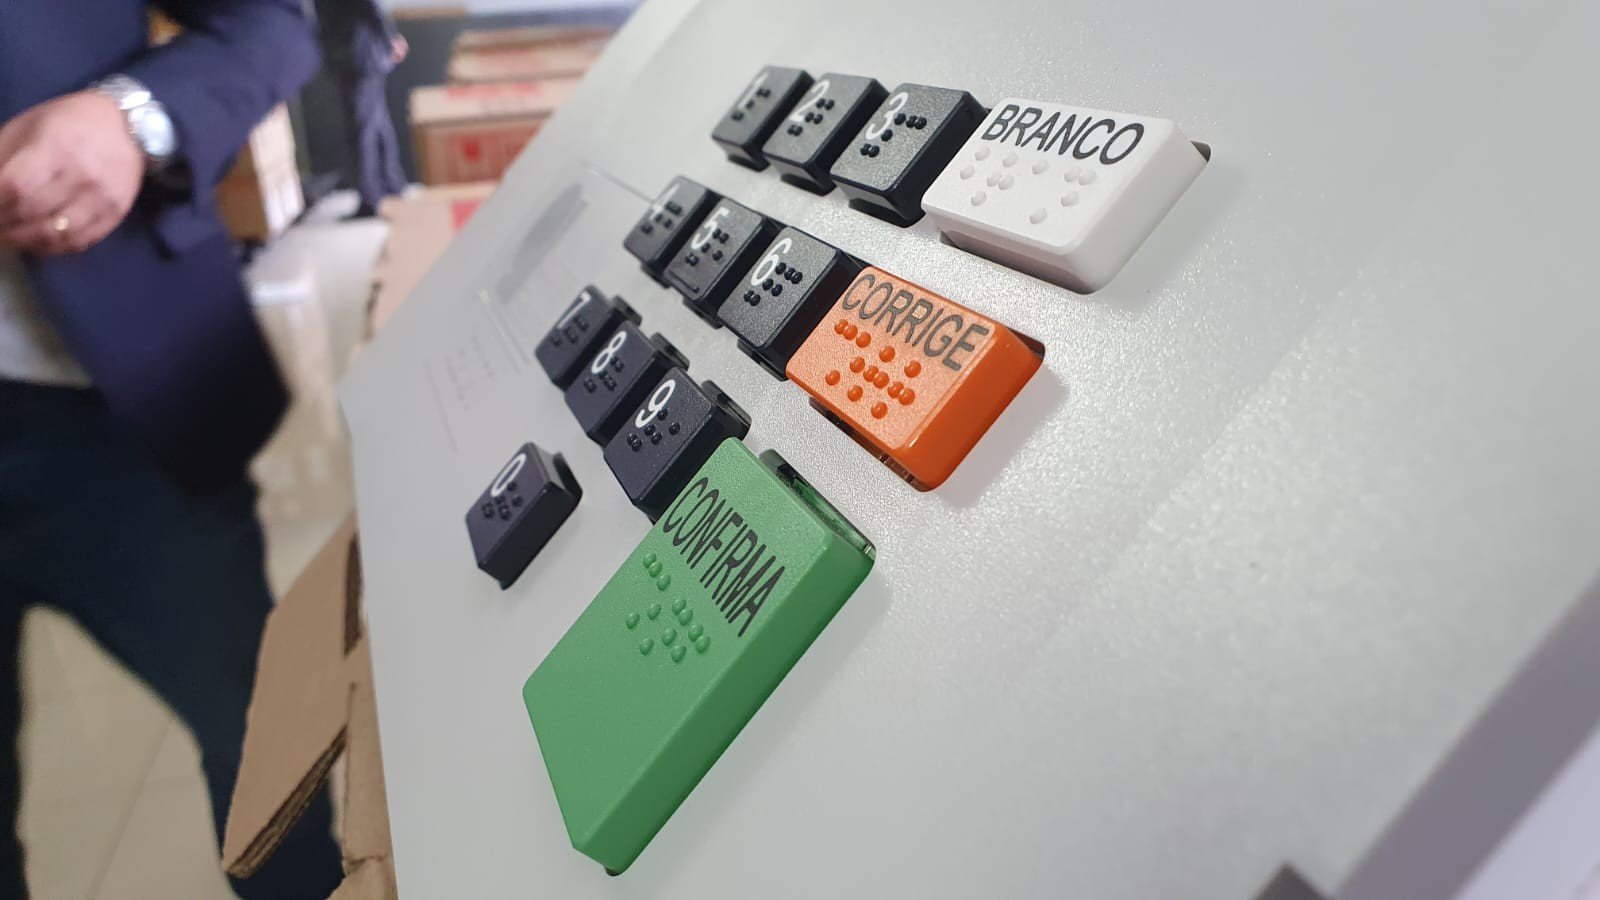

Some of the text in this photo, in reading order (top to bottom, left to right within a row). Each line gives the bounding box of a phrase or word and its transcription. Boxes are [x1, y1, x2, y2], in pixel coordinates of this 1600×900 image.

[788, 79, 830, 123] 2
[865, 91, 907, 141] 3
[981, 103, 1145, 165] BRANCO
[690, 208, 728, 250] 5
[750, 237, 793, 287] 6
[556, 291, 591, 329] 7
[841, 274, 990, 372] CORRIGE
[592, 330, 627, 374] 8
[635, 379, 676, 428] 9
[490, 453, 527, 497] 0
[663, 476, 785, 638] CONFIRMA
